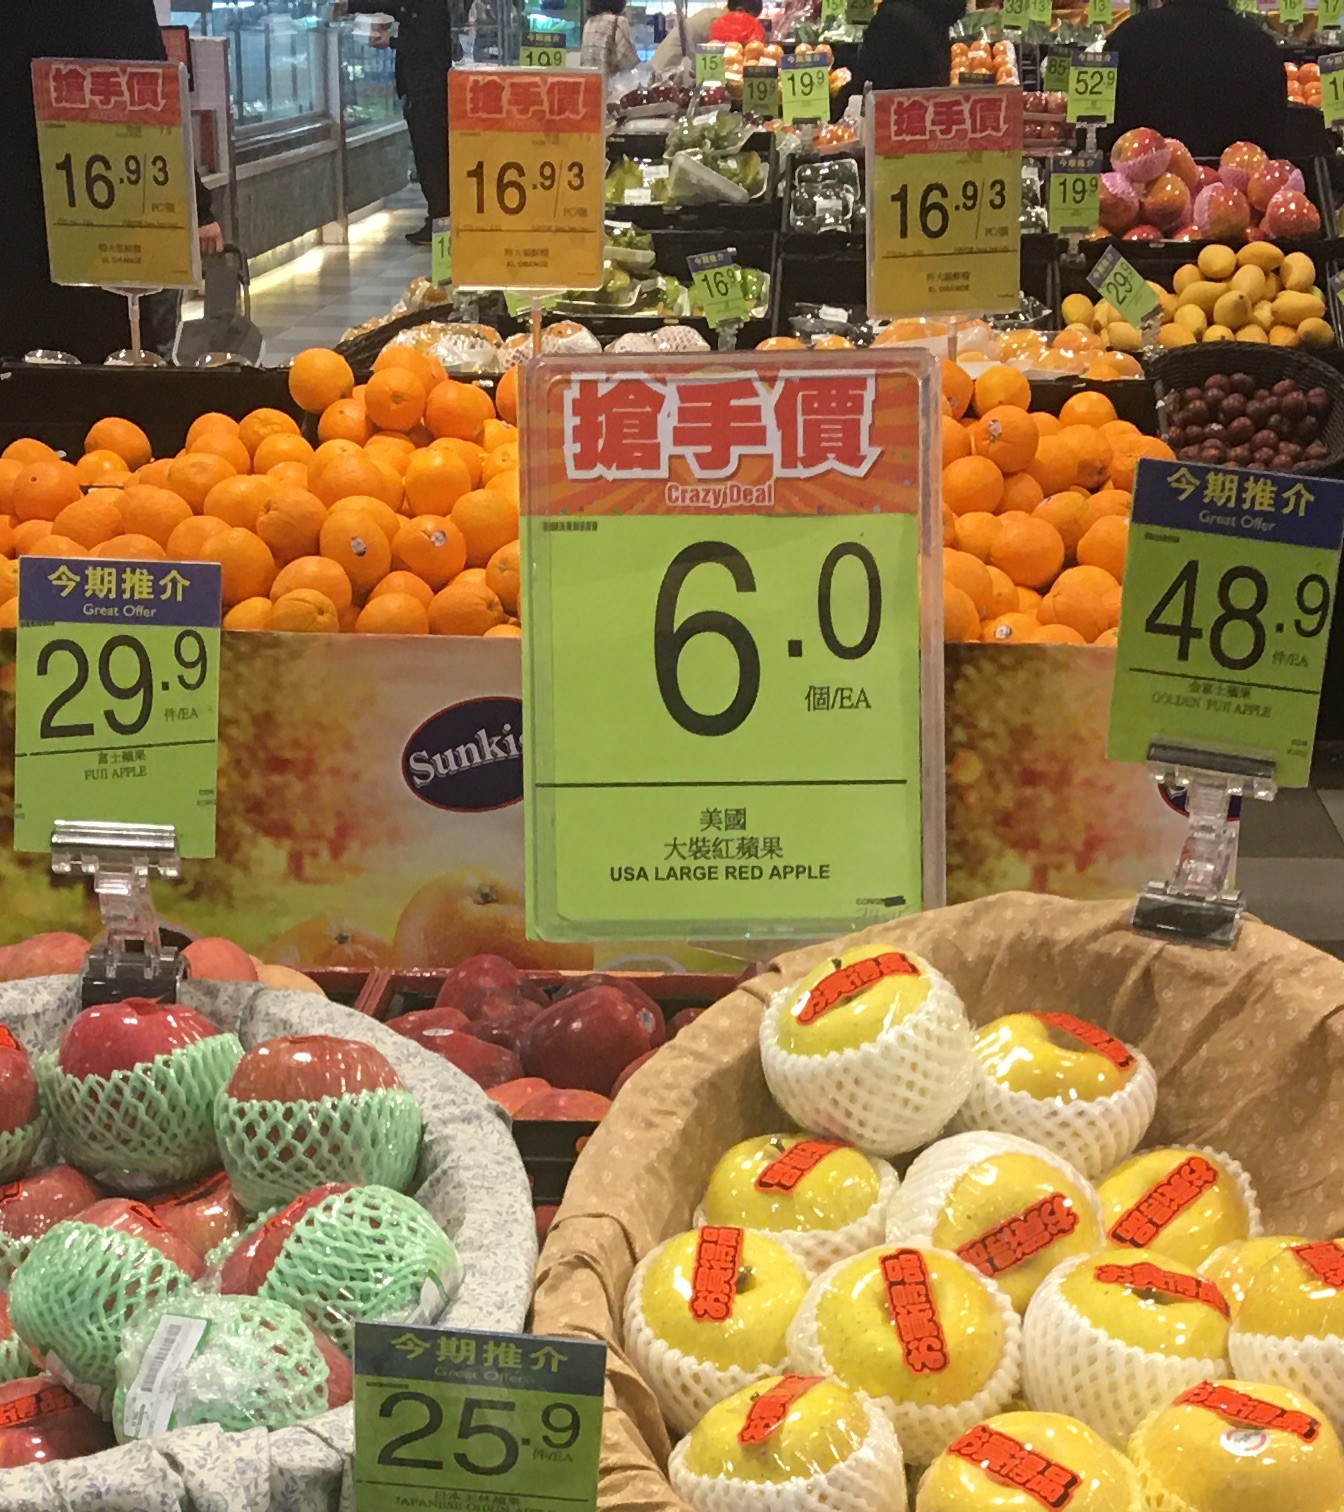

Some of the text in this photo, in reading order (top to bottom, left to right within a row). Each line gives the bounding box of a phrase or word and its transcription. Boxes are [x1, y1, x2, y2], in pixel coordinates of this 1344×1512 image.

[891, 96, 1009, 140] 搶手價
[563, 369, 884, 481] 搶手價
[665, 481, 775, 508] Crazy Deal
[1167, 466, 1316, 517] 今期推介
[1240, 515, 1276, 532] Offer
[48, 564, 191, 602] 今期推介
[83, 603, 157, 619] Great Offer
[1145, 559, 1331, 670] 48.9
[654, 540, 883, 737] 6.0
[36, 629, 208, 740] 29.9
[805, 685, 872, 712] 個/EA
[111, 766, 147, 779] APPLE
[409, 723, 523, 788] Sunki
[699, 807, 747, 832] 美國
[663, 835, 784, 861] 大裝紅蘋果
[609, 863, 831, 882] USA LARGE RED APPLE
[391, 1332, 569, 1373] 今期推介
[377, 1391, 581, 1477] 25.9
